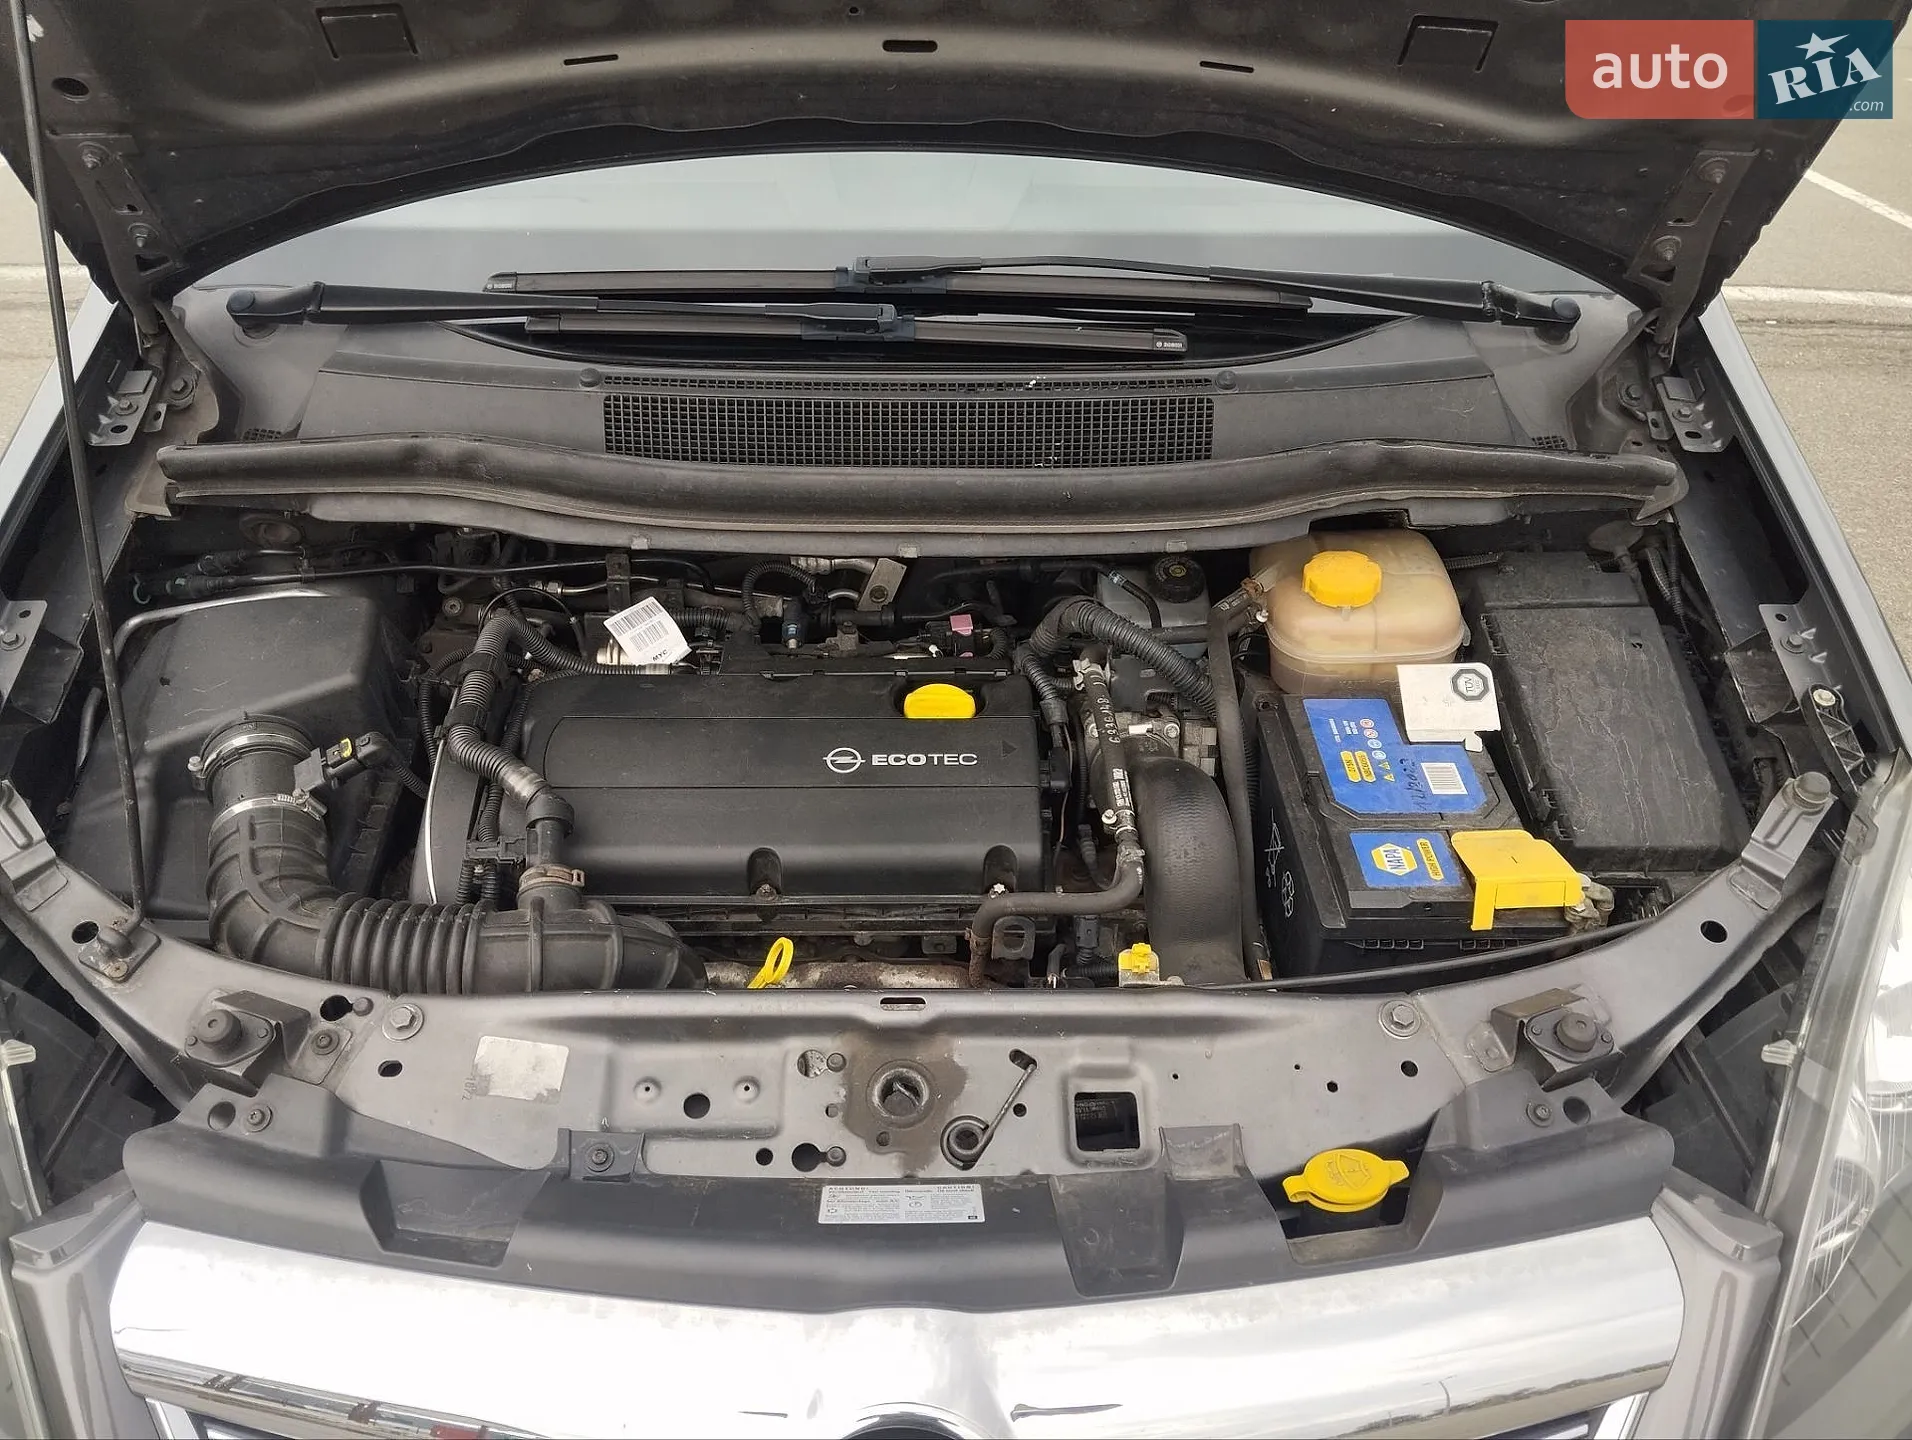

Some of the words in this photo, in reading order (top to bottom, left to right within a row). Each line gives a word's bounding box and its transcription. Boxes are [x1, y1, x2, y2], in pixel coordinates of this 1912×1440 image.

[871, 753, 978, 766] ECOTEC
[1383, 849, 1407, 870] NAPA
[1419, 841, 1434, 861] POWER
[1427, 862, 1441, 877] HIGH
